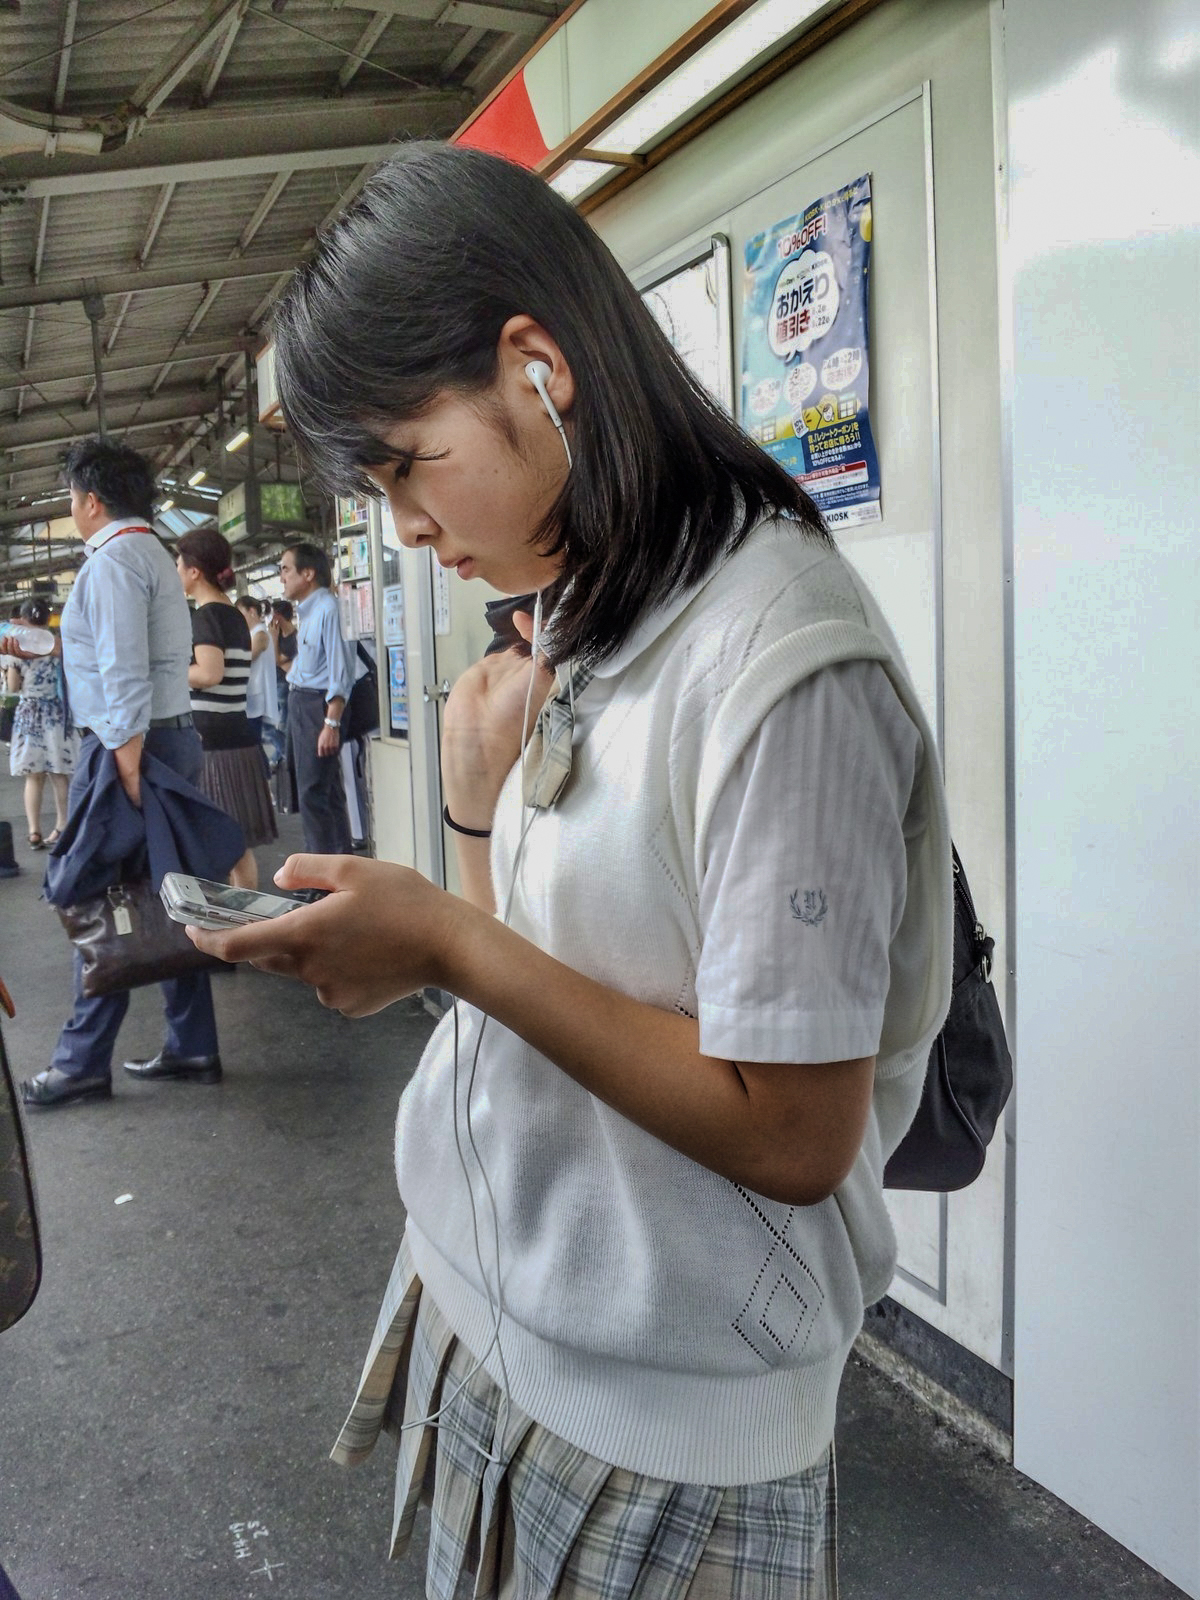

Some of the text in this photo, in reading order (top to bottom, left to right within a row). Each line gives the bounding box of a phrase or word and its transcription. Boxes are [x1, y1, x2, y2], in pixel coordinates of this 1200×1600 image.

[777, 214, 828, 258] 10%OFF!
[776, 272, 830, 319] おかえり
[776, 309, 811, 343] 値引き
[826, 511, 849, 523] KIOSK
